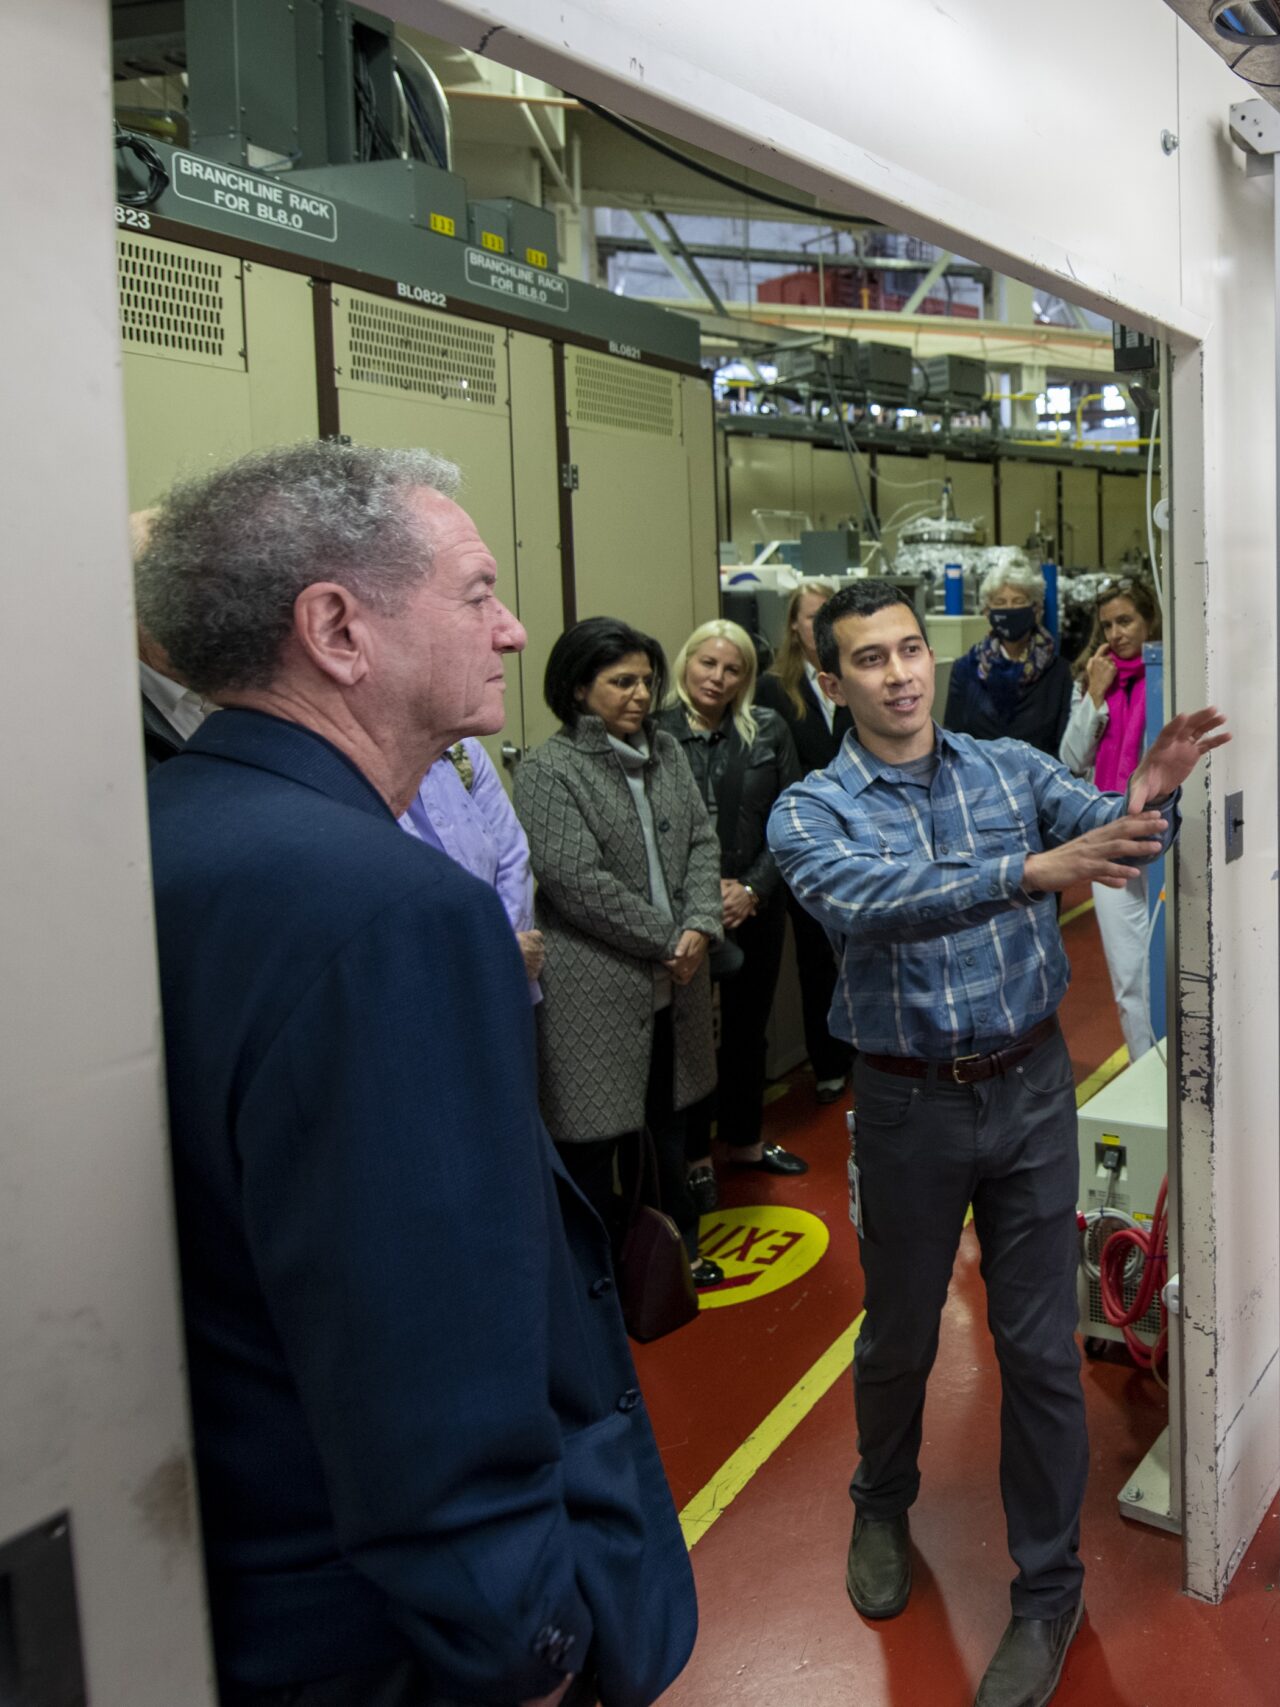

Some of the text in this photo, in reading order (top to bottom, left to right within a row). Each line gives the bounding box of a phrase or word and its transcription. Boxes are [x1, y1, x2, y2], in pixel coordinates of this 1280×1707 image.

[180, 157, 330, 219] BRANCHLINE RACK
[214, 190, 303, 229] FOR BL8.0
[469, 252, 564, 293] BRANCHLINE RACK
[491, 275, 514, 293] FOR
[397, 282, 447, 308] BL0822
